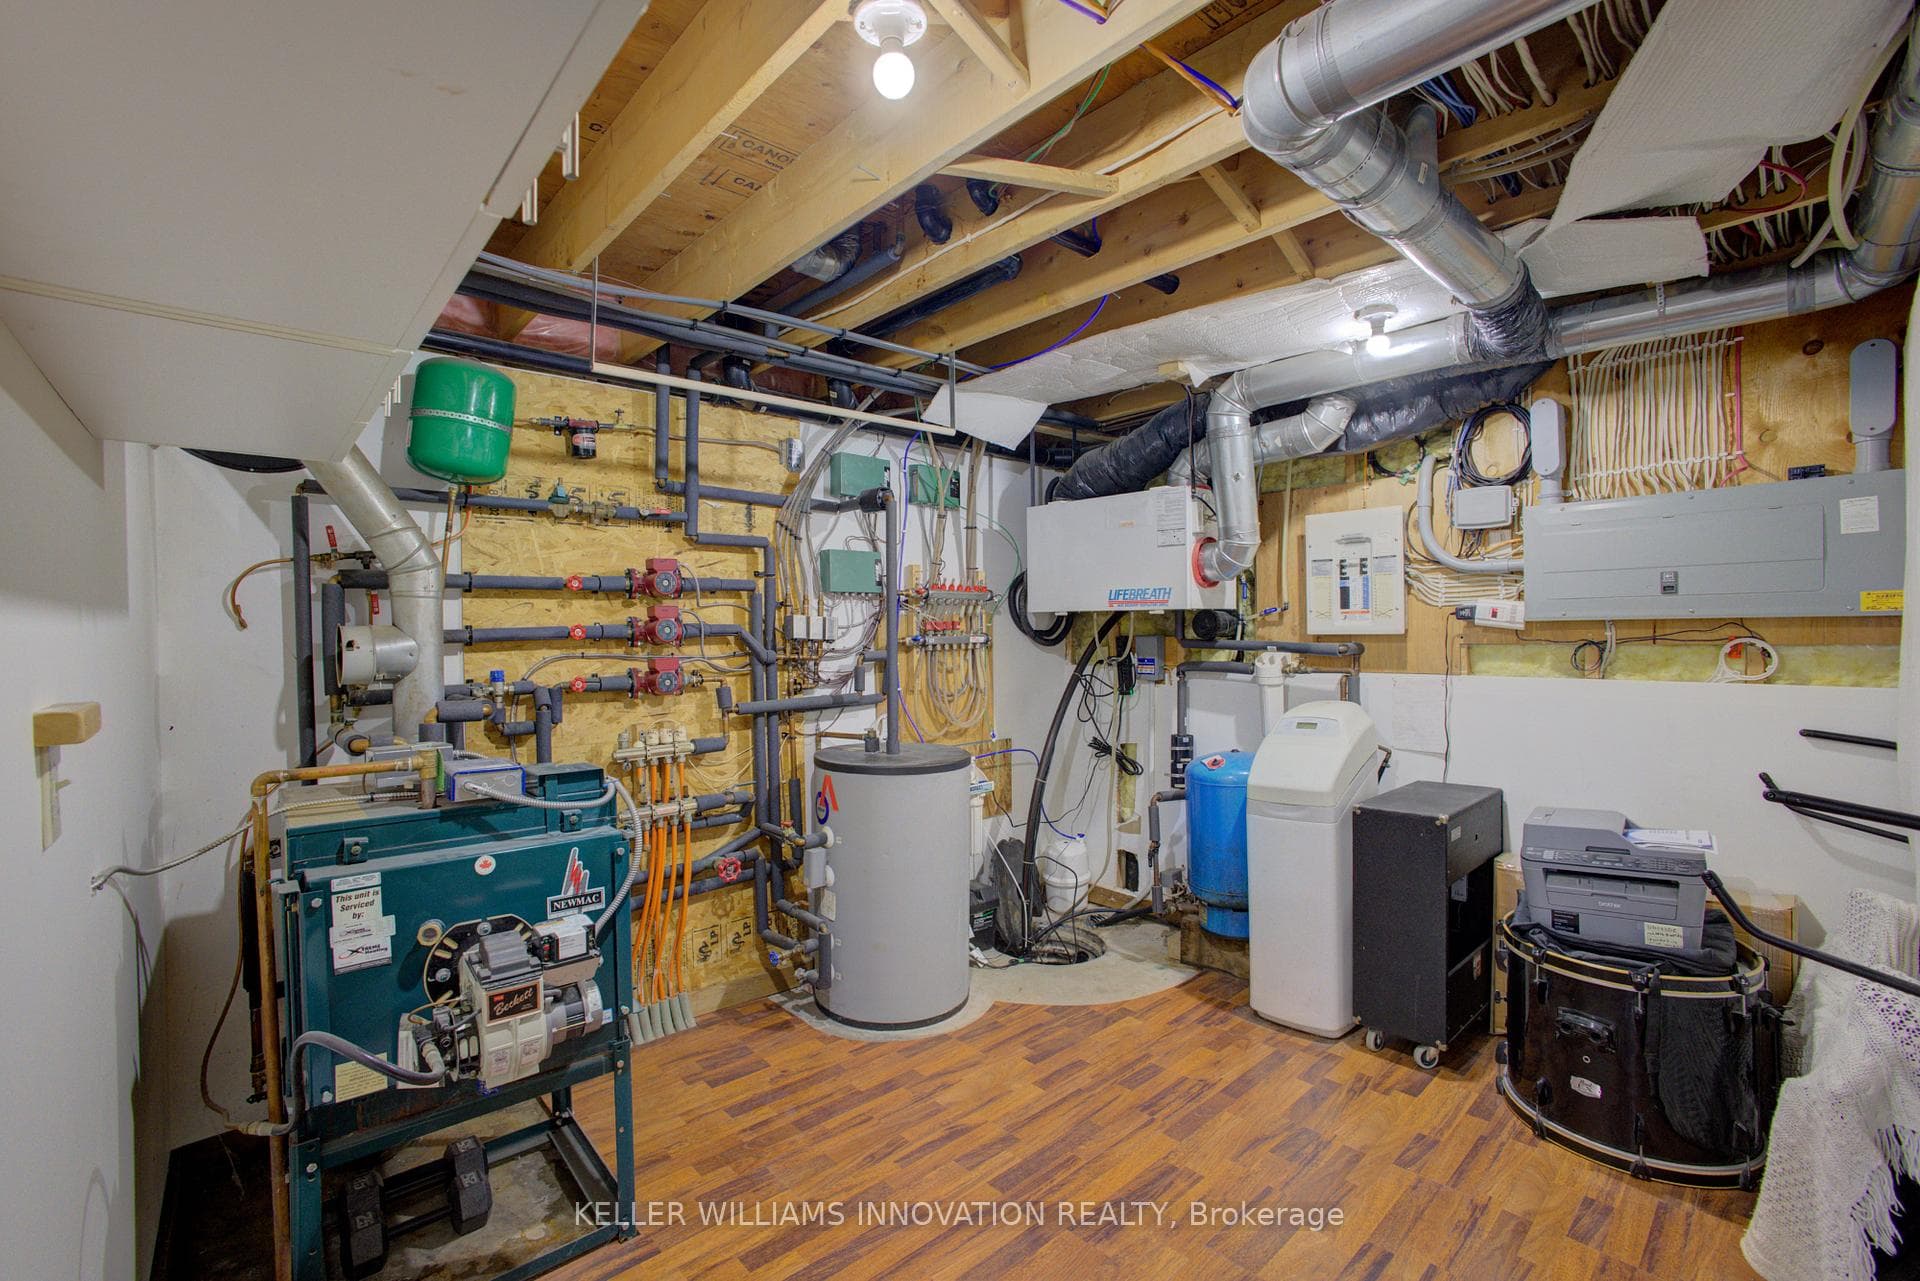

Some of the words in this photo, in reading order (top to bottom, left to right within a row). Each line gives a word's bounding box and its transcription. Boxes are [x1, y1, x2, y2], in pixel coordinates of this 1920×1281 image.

[1108, 587, 1171, 601] LIFEBREATH
[336, 894, 352, 903] This
[354, 890, 370, 900] unit
[553, 894, 599, 911] NEWMAC
[340, 899, 375, 912] Serviced
[352, 912, 364, 920] by:
[493, 987, 534, 1016] Beckett
